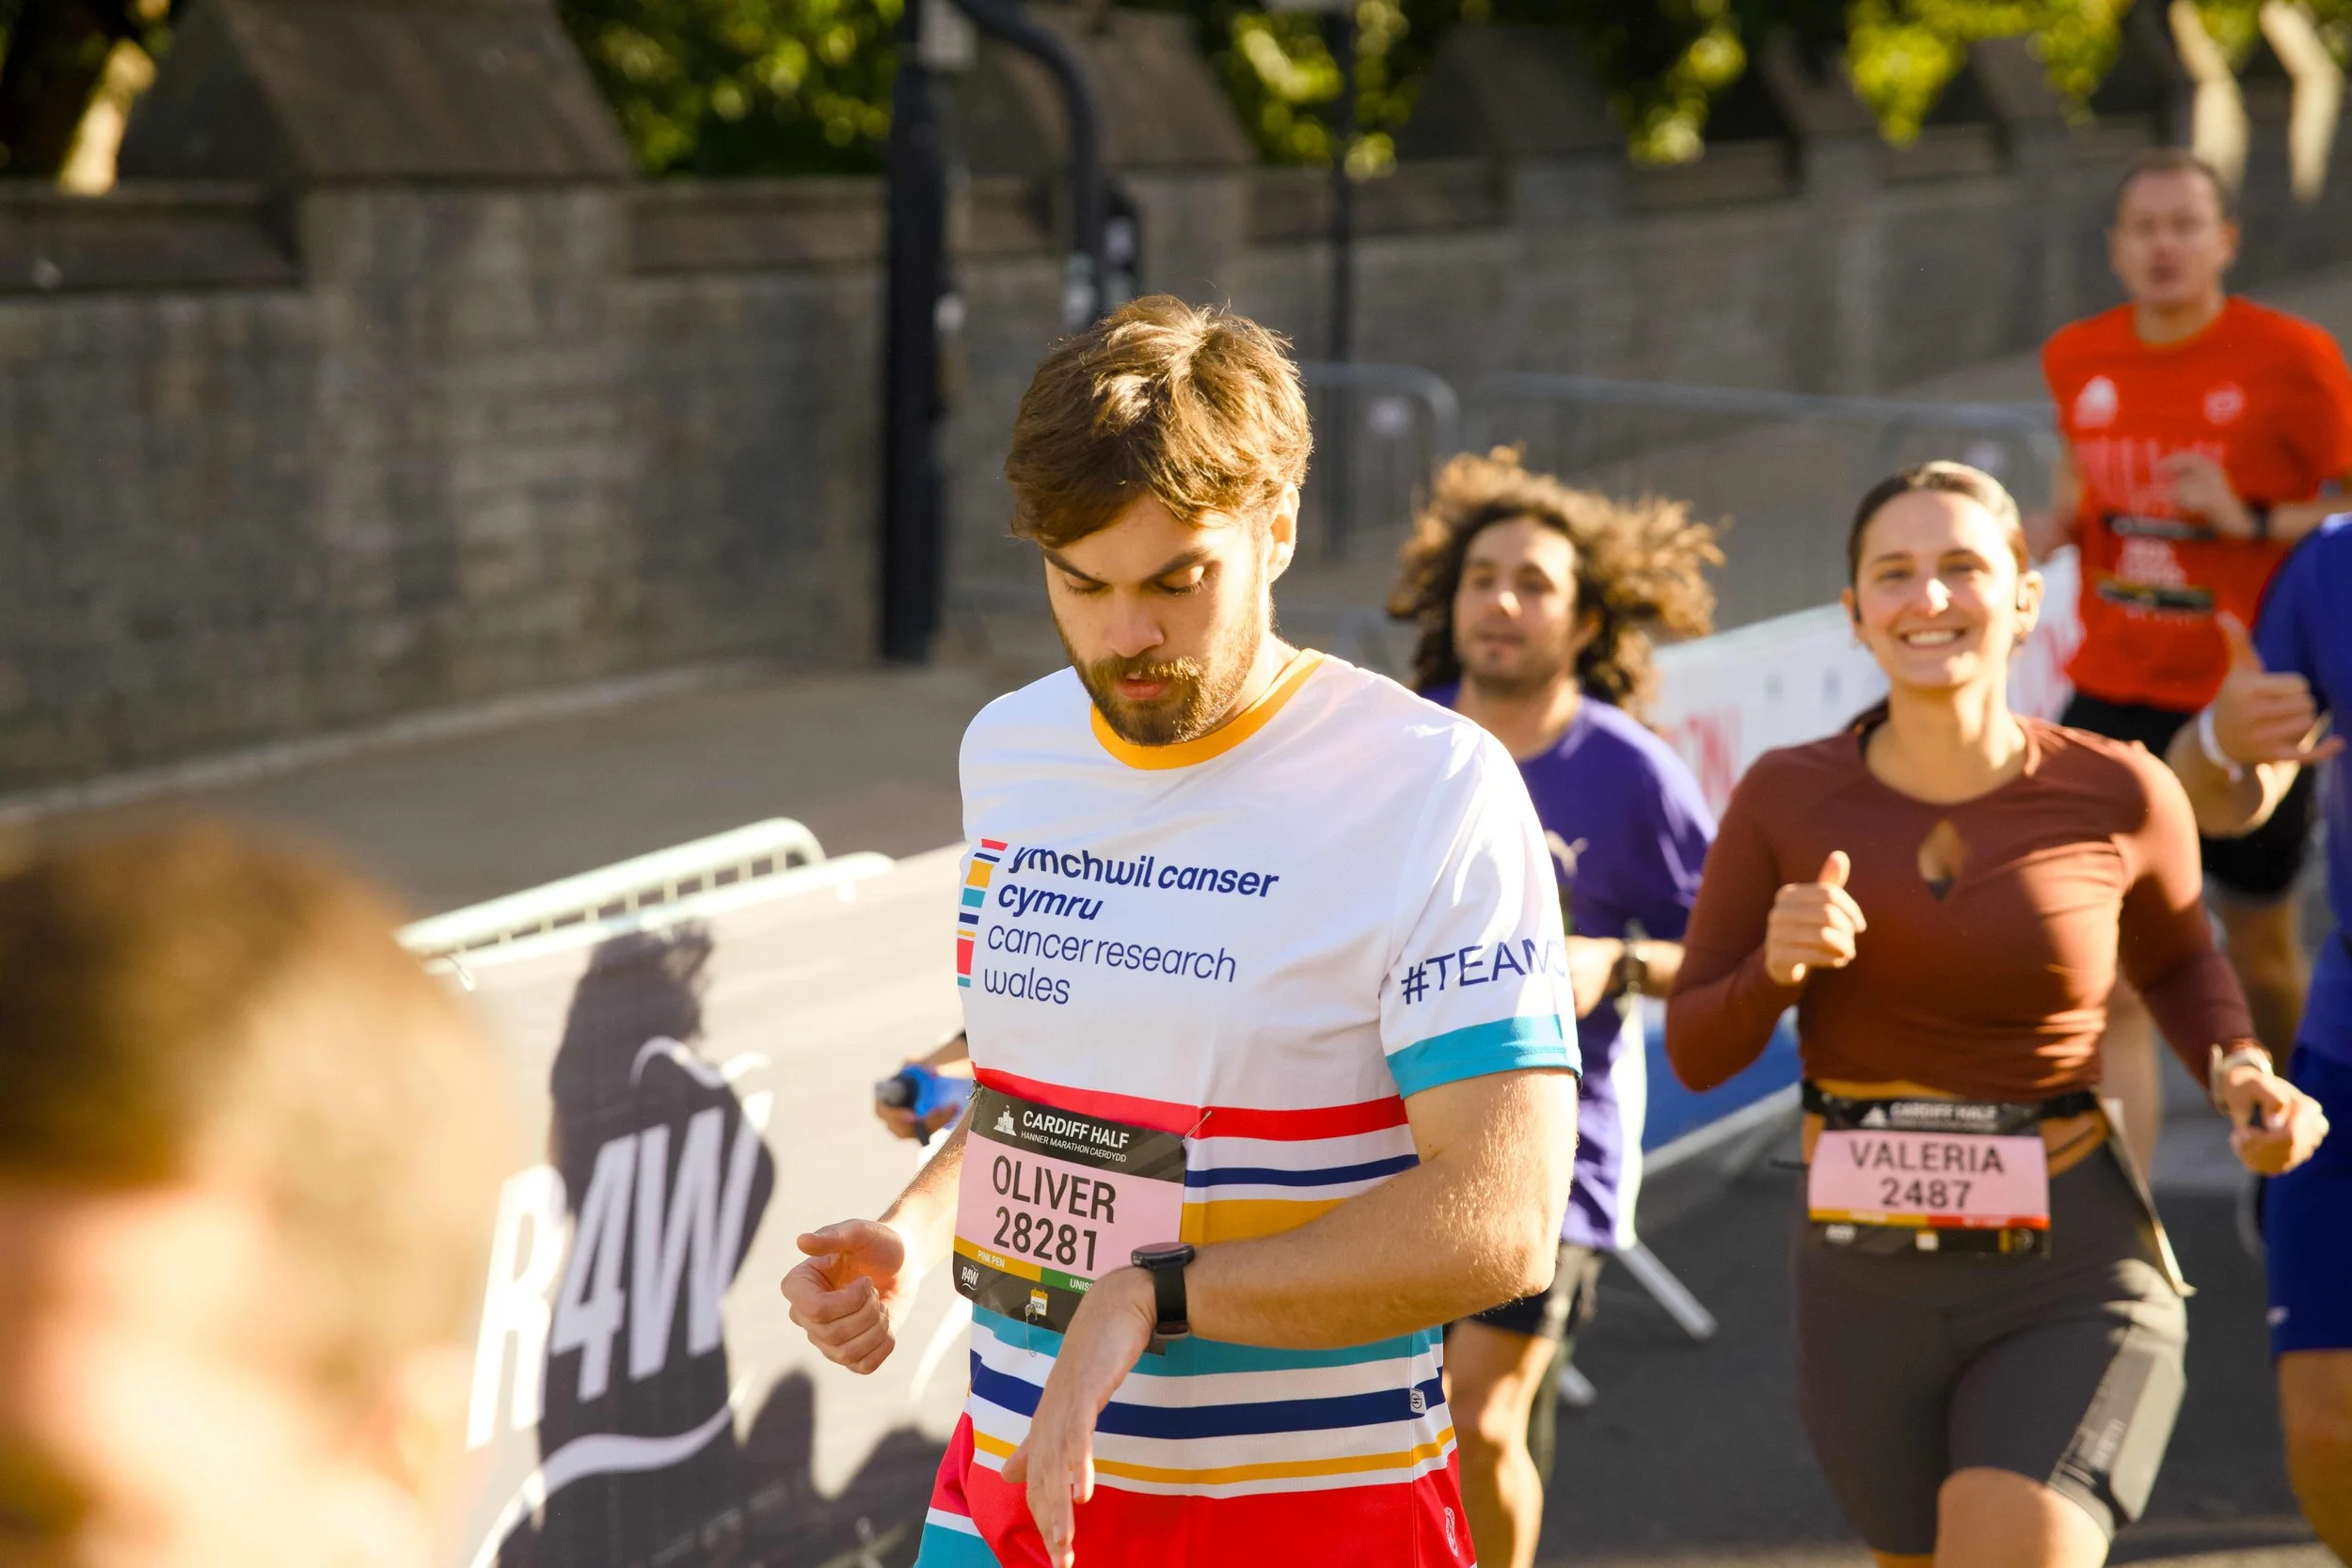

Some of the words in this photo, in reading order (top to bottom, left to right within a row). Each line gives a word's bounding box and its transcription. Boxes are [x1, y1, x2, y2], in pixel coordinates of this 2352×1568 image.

[1009, 847, 1154, 888] ymchwil
[1158, 863, 1279, 897] canser
[998, 883, 1104, 920] cymru
[988, 925, 1093, 963] cancer
[1095, 939, 1236, 982] research
[984, 968, 1071, 1005] wales
[1021, 1131, 1049, 1145] HANNER
[1049, 1137, 1090, 1155] MARATHON
[1089, 1147, 1127, 1163] CAERDYDD
[1023, 1110, 1089, 1140] CARDIFF
[1089, 1126, 1130, 1148] HALF
[1849, 1139, 2005, 1175] VALERIA
[992, 1155, 1117, 1224] OLIVER
[1881, 1178, 1972, 1210] 2487
[993, 1206, 1098, 1272] 28281
[466, 1091, 773, 1451] R4W
[977, 1249, 992, 1264] PINK
[991, 1255, 1006, 1269] PEN
[1069, 1277, 1093, 1291] UNIS
